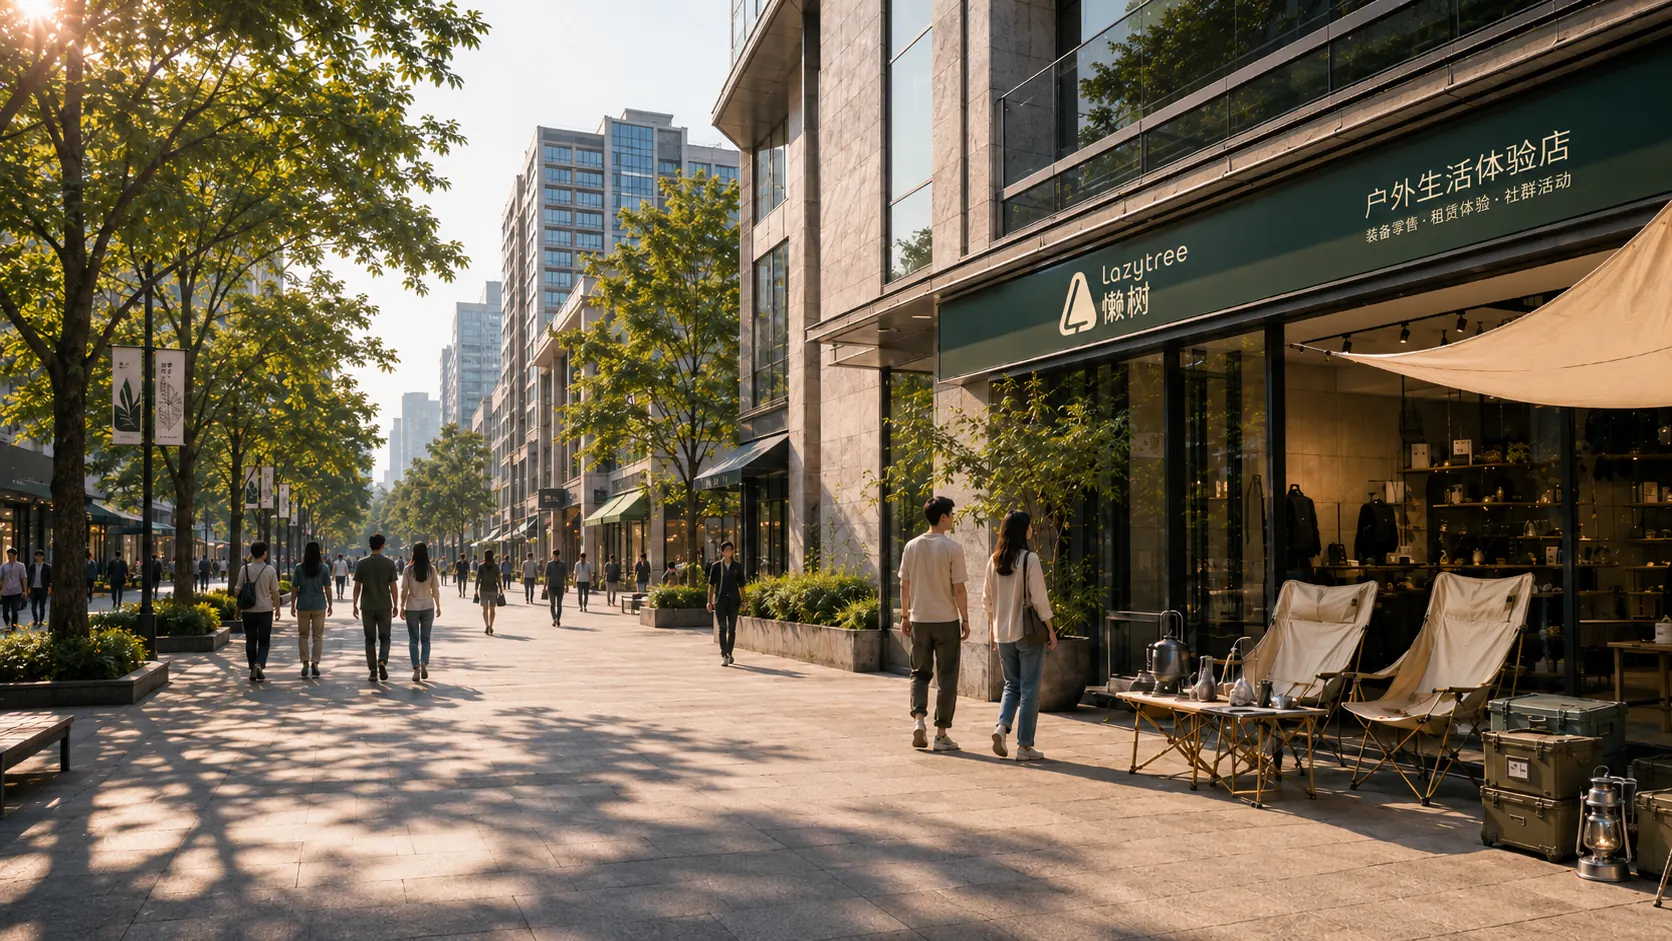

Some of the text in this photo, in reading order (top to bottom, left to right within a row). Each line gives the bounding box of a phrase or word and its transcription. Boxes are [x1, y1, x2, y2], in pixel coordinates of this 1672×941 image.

[1365, 129, 1571, 219] 户外生活体验店
[1101, 281, 1150, 325] 懒树
